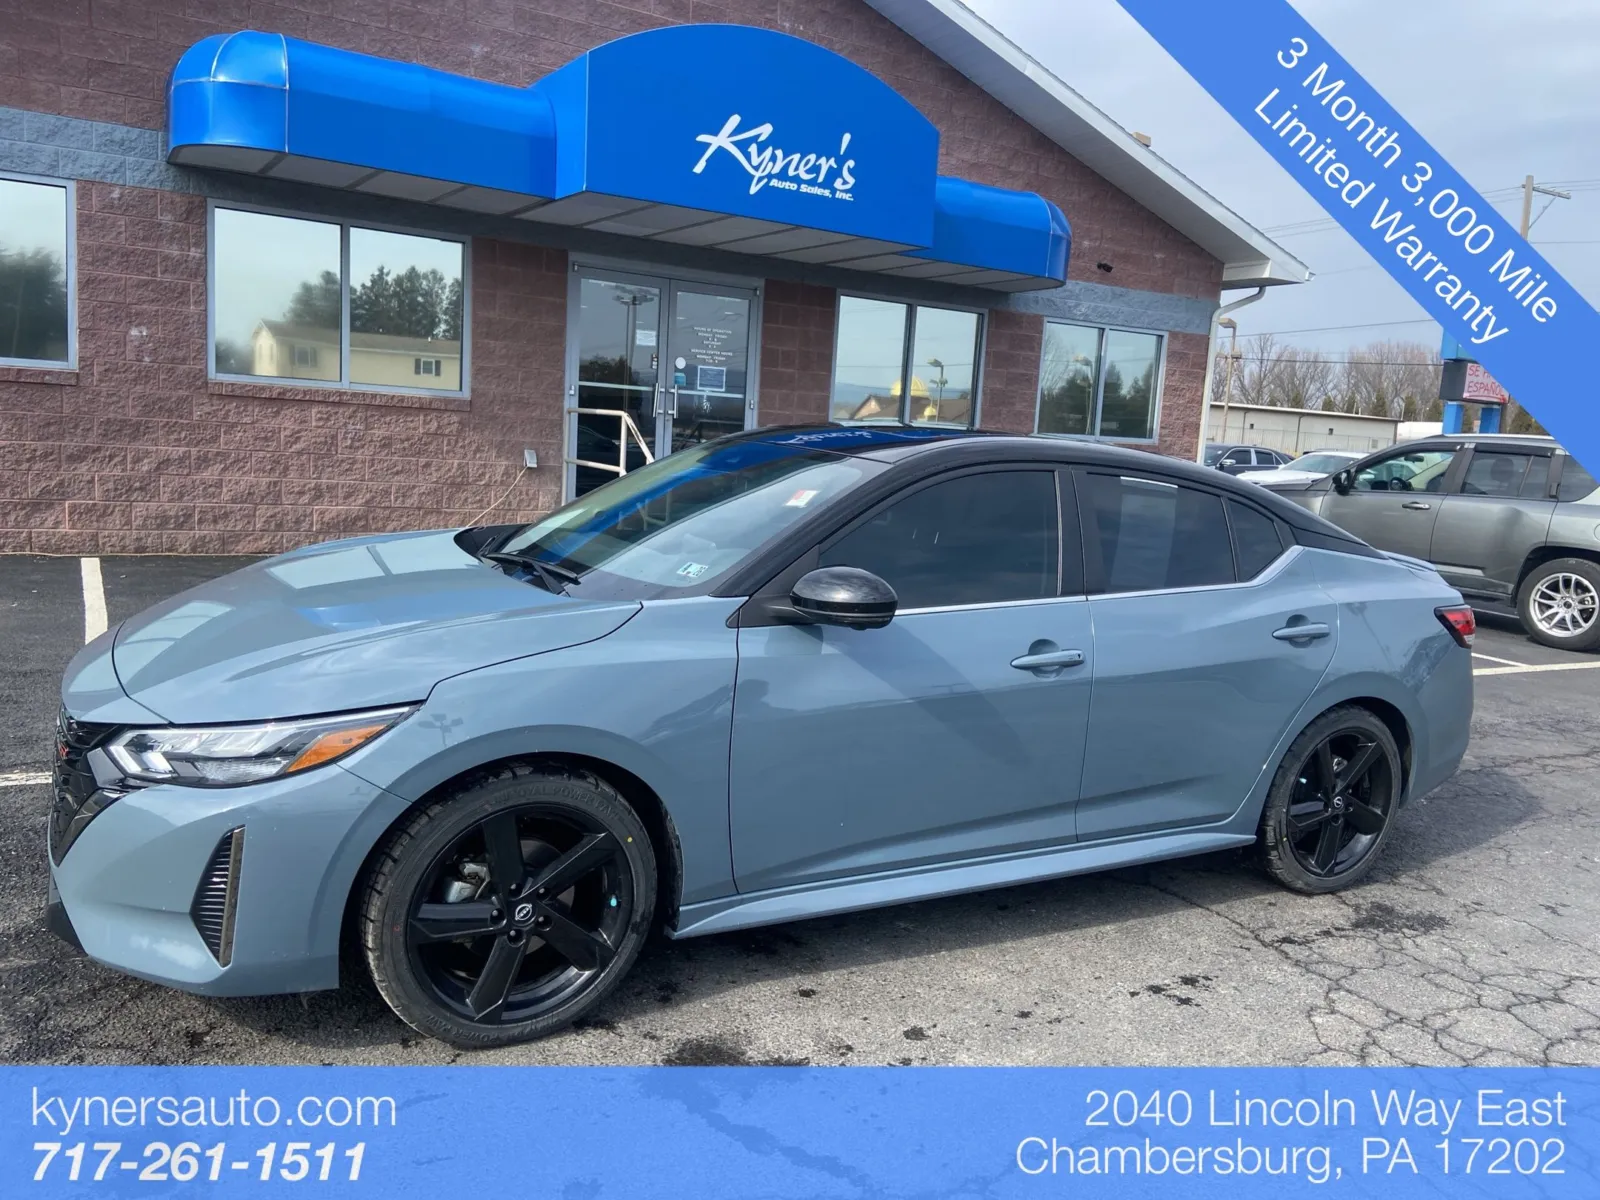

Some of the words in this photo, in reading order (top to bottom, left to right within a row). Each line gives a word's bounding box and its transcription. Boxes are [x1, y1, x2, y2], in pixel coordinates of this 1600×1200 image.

[692, 113, 856, 195] Kyner's
[769, 178, 798, 191] Auto
[799, 183, 833, 198] Sales,
[835, 190, 855, 201] Inc.
[1468, 365, 1480, 377] SE
